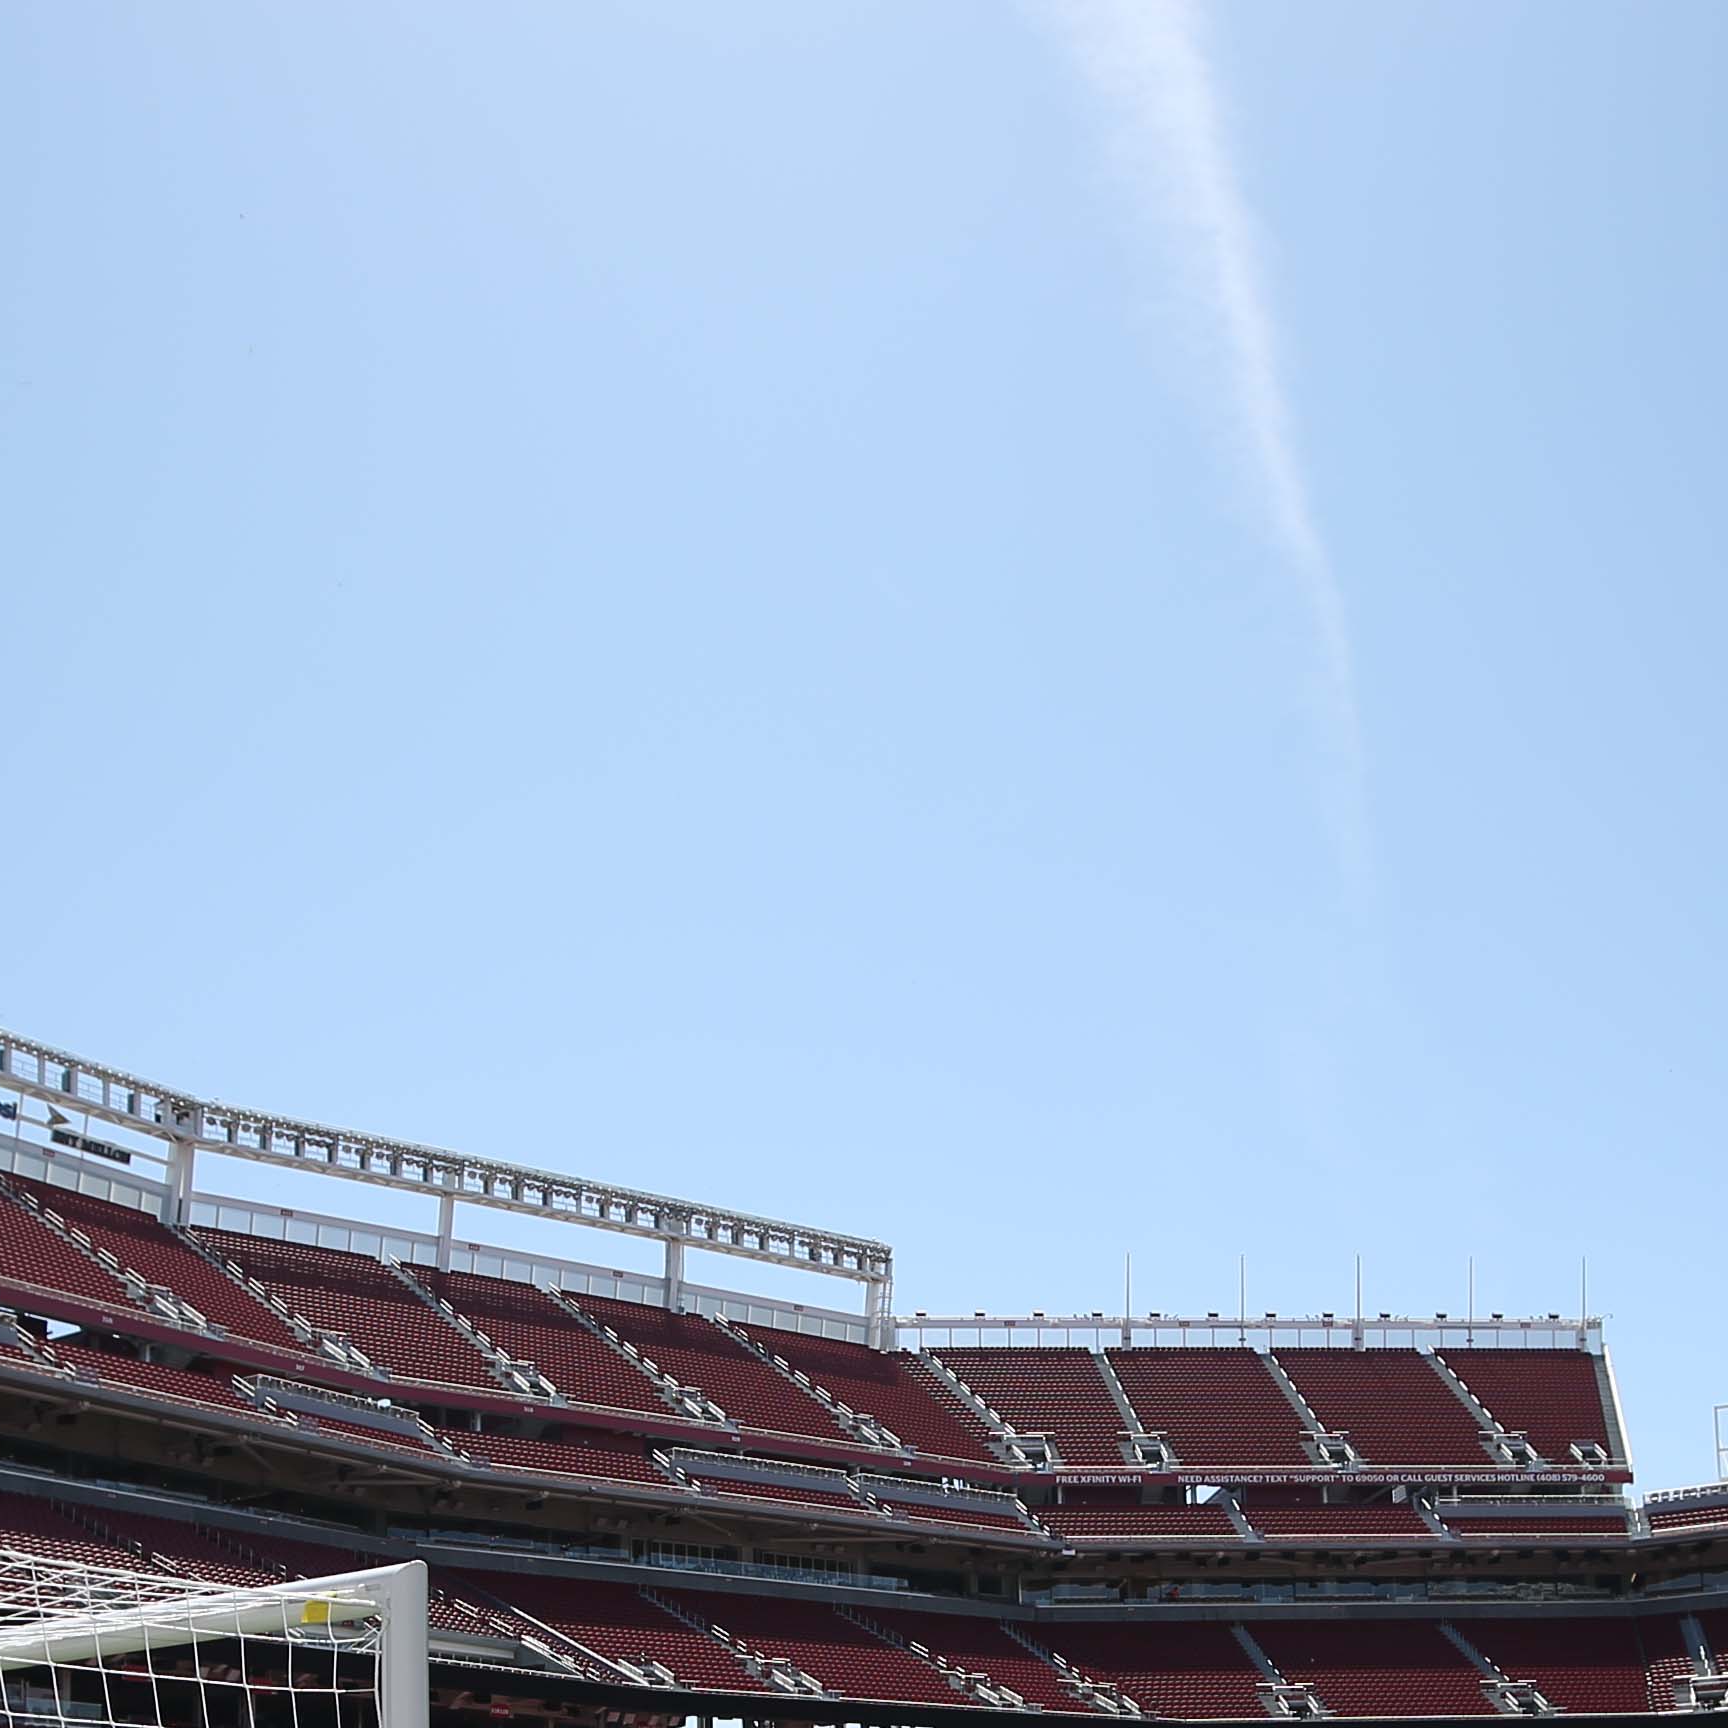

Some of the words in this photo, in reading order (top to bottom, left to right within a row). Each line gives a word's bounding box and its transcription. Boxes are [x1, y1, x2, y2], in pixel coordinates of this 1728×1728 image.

[1056, 1475, 1080, 1484] FREE
[1080, 1475, 1117, 1484] XFINITY
[1118, 1475, 1142, 1484] WI-FI
[1178, 1475, 1203, 1484] NEED
[1204, 1475, 1263, 1484] ASSISTANCE?
[1265, 1475, 1288, 1483] TEXT
[1342, 1474, 1354, 1482] TO
[1356, 1474, 1385, 1482] 69050
[1386, 1474, 1400, 1482] OR
[1401, 1474, 1423, 1482] CALL
[1425, 1474, 1453, 1482] GUEST
[1454, 1474, 1496, 1483] SERVICES
[1497, 1474, 1535, 1483] HOTLINE
[1536, 1474, 1561, 1483] (408)
[1562, 1474, 1605, 1482] 579-4600
